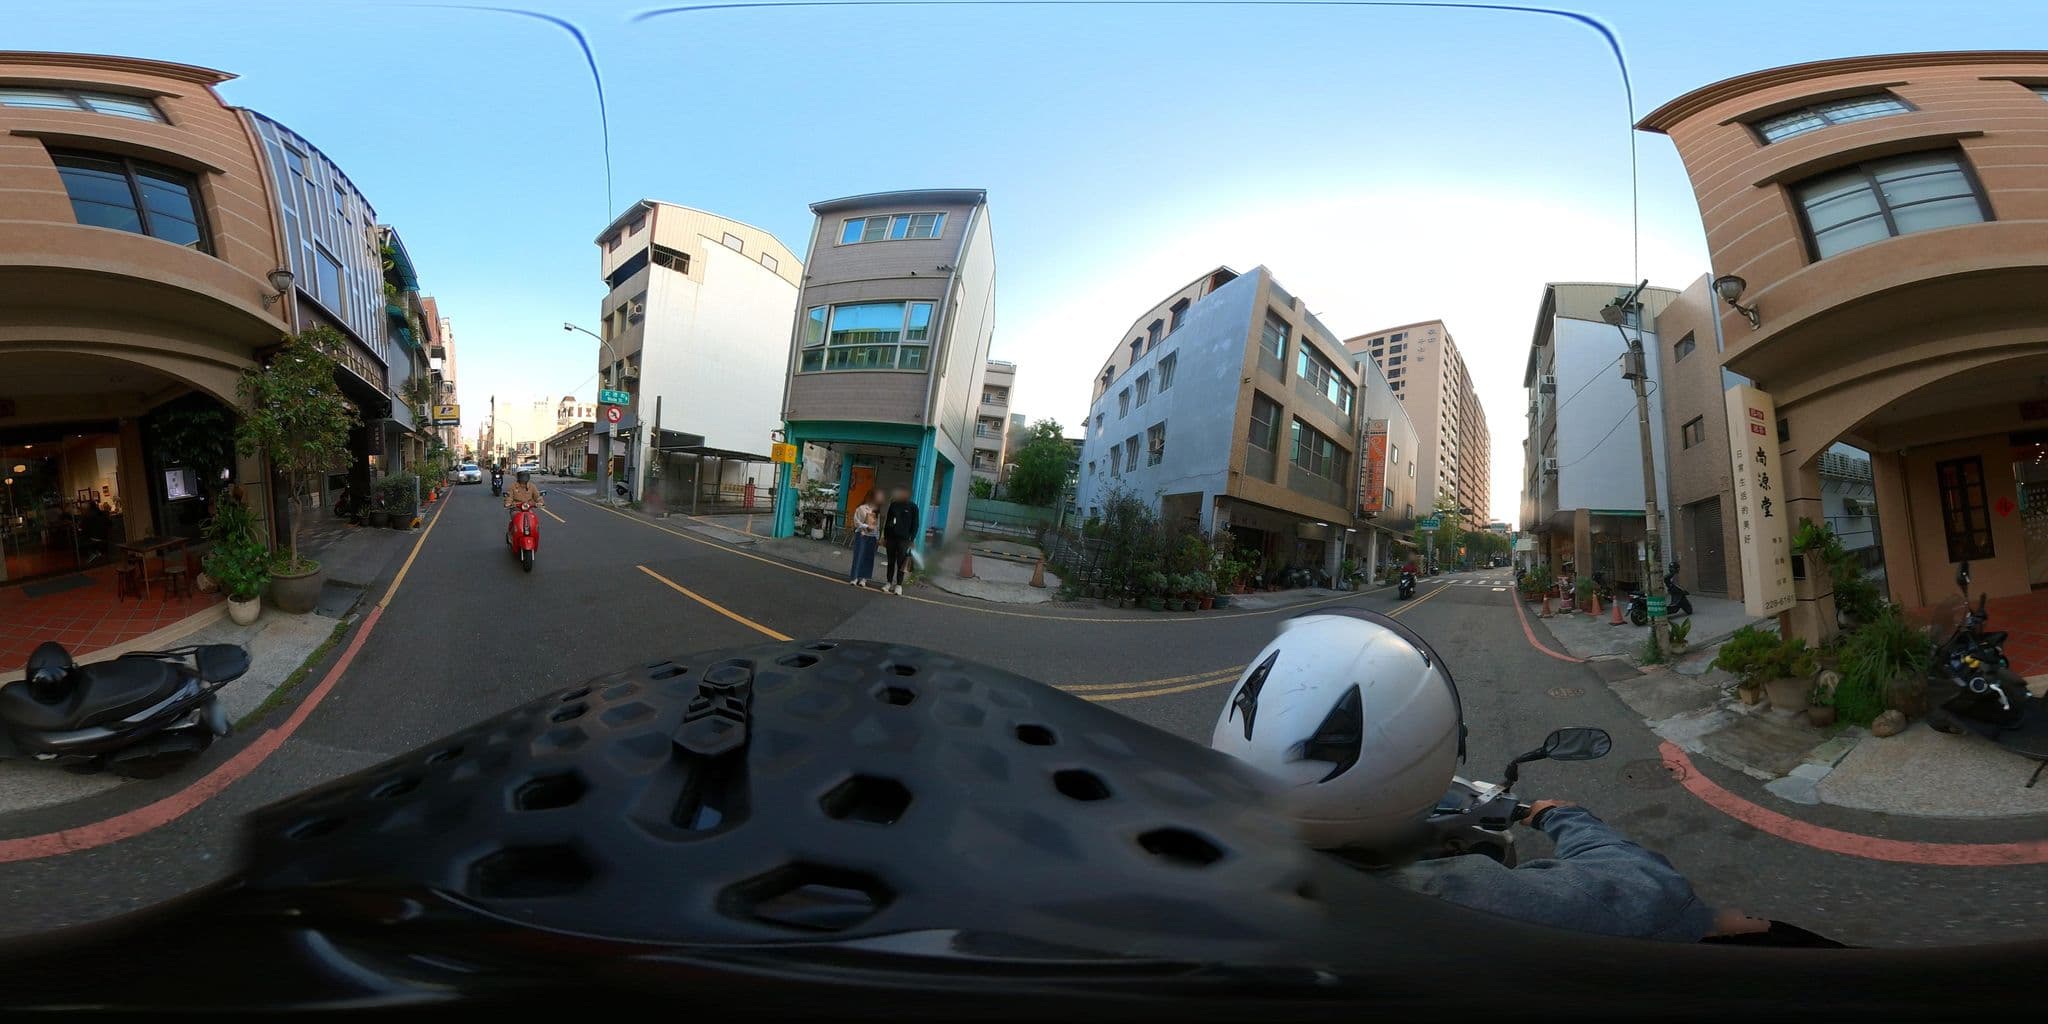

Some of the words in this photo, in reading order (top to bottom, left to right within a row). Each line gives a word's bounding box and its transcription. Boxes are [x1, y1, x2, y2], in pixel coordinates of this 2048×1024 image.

[1737, 449, 1751, 544] 日常生活的美好
